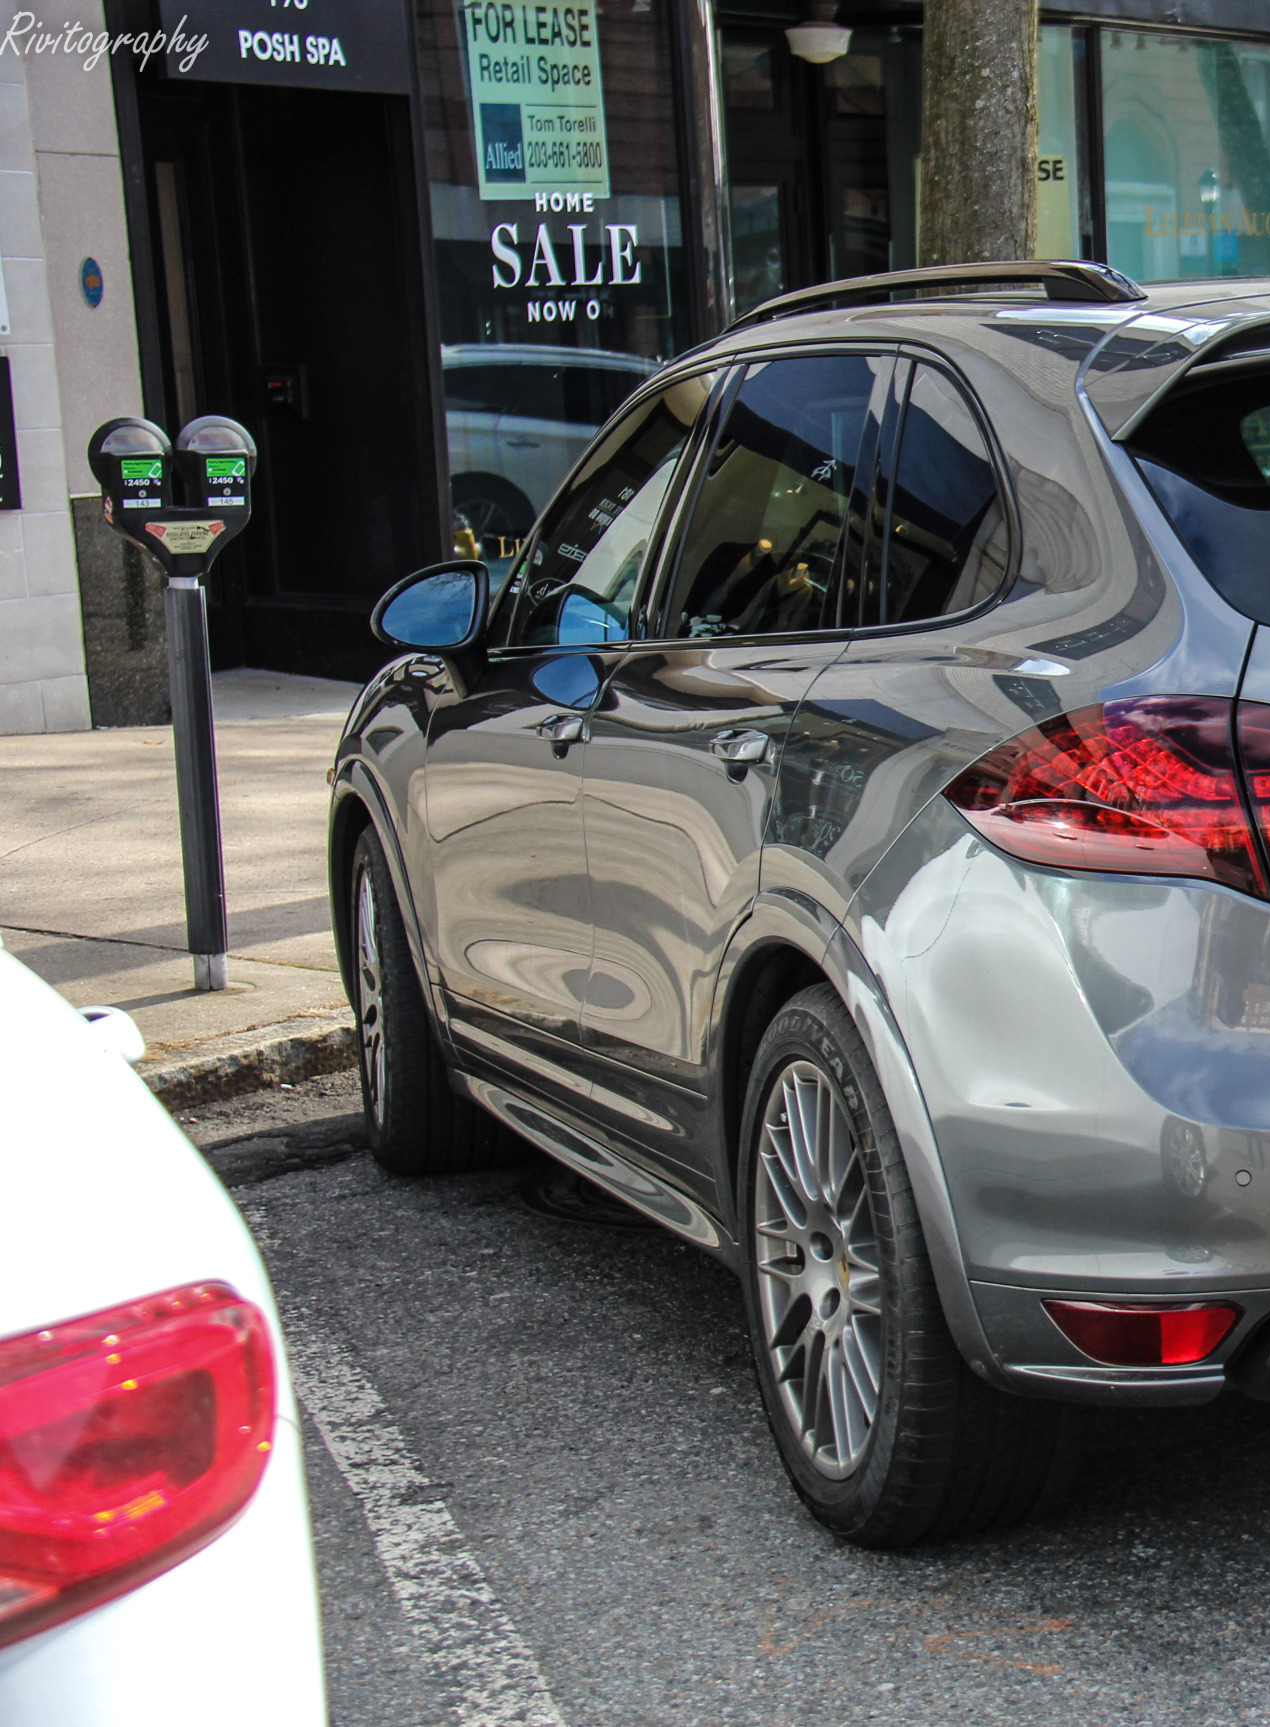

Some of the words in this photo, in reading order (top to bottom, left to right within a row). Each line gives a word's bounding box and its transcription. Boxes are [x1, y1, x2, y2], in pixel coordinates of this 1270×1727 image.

[471, 3, 516, 44] FOR
[522, 5, 592, 48] LEASE
[238, 28, 301, 63] POSH
[305, 34, 347, 67] SPA
[479, 53, 531, 84] Retail
[537, 56, 591, 93] Space
[528, 115, 554, 132] Tom
[557, 116, 597, 133] Torelli
[486, 141, 523, 169] Allied
[528, 141, 603, 169] 203-661-5800
[1036, 160, 1065, 181] SE
[535, 192, 595, 213] HOME
[1145, 206, 1236, 237] LILLIAN
[491, 222, 642, 289] SALE
[527, 301, 576, 323] NOW
